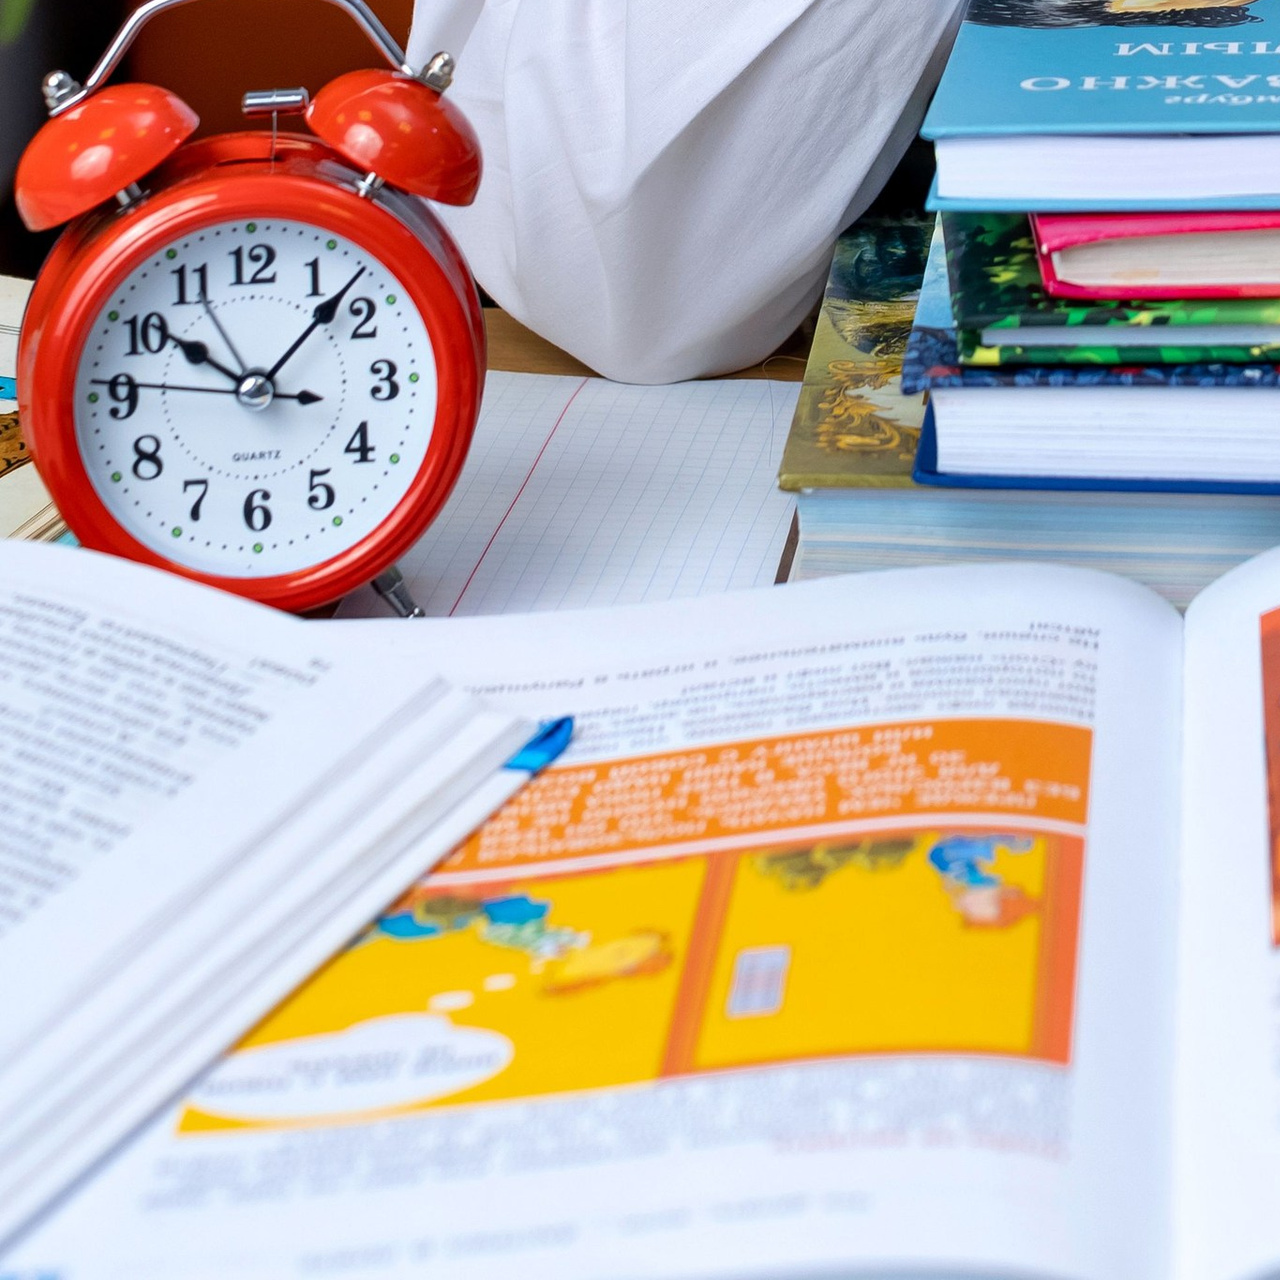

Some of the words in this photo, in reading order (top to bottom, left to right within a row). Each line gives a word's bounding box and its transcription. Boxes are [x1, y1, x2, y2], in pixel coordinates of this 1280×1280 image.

[170, 262, 214, 307] 11
[227, 243, 278, 286] 12
[303, 256, 326, 298] 1
[122, 311, 169, 357] 10
[348, 296, 379, 340] 2
[107, 372, 140, 421] 9
[369, 358, 401, 402] 3
[131, 434, 164, 481] 8
[232, 449, 283, 463] QUARTZ
[343, 419, 377, 465] 4
[182, 478, 210, 523] 7
[242, 487, 273, 533] 6
[306, 467, 337, 512] 5
